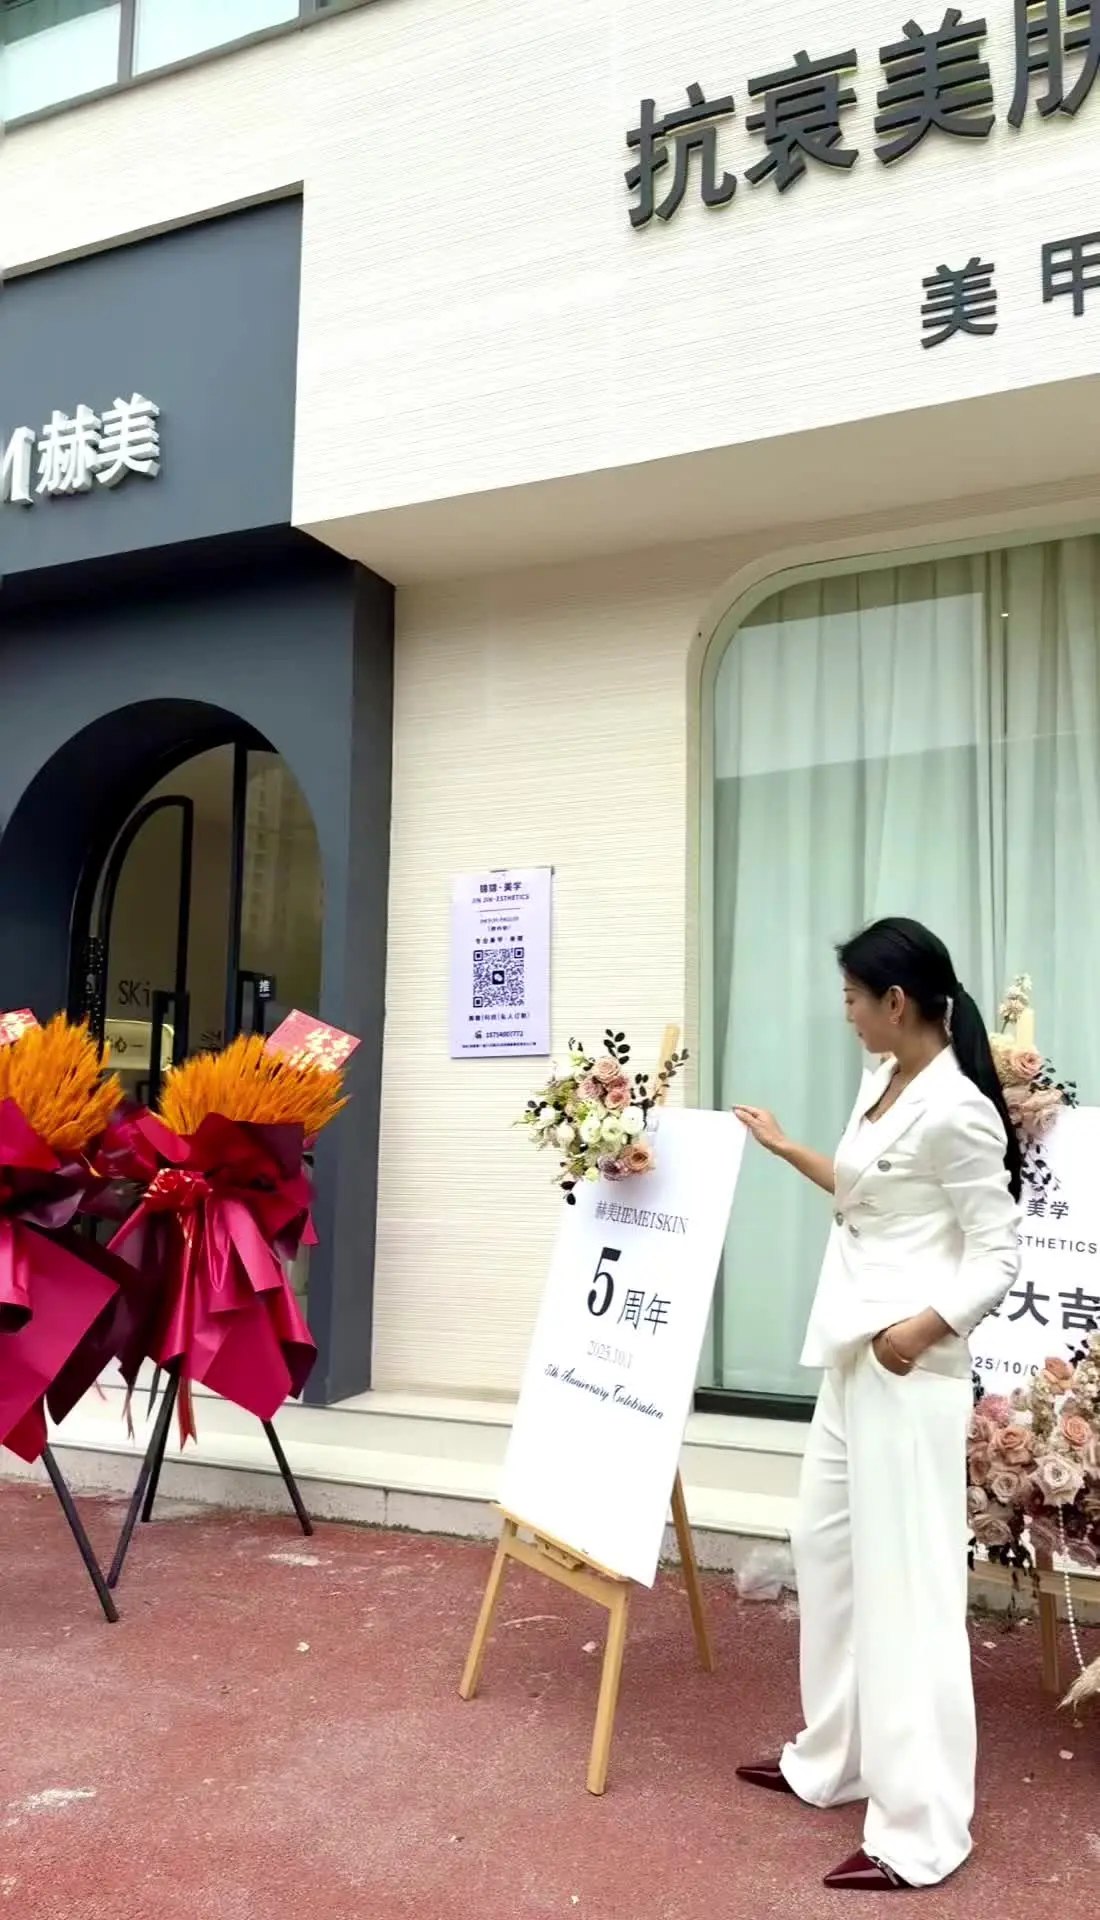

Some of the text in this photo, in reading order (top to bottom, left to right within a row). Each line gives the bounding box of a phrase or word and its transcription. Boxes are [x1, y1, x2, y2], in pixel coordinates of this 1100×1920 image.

[36, 392, 160, 496] 赫美
[1027, 1199, 1070, 1220] 美学
[970, 1281, 1100, 1332] 大吉
[560, 1366, 611, 1401] Anniversary
